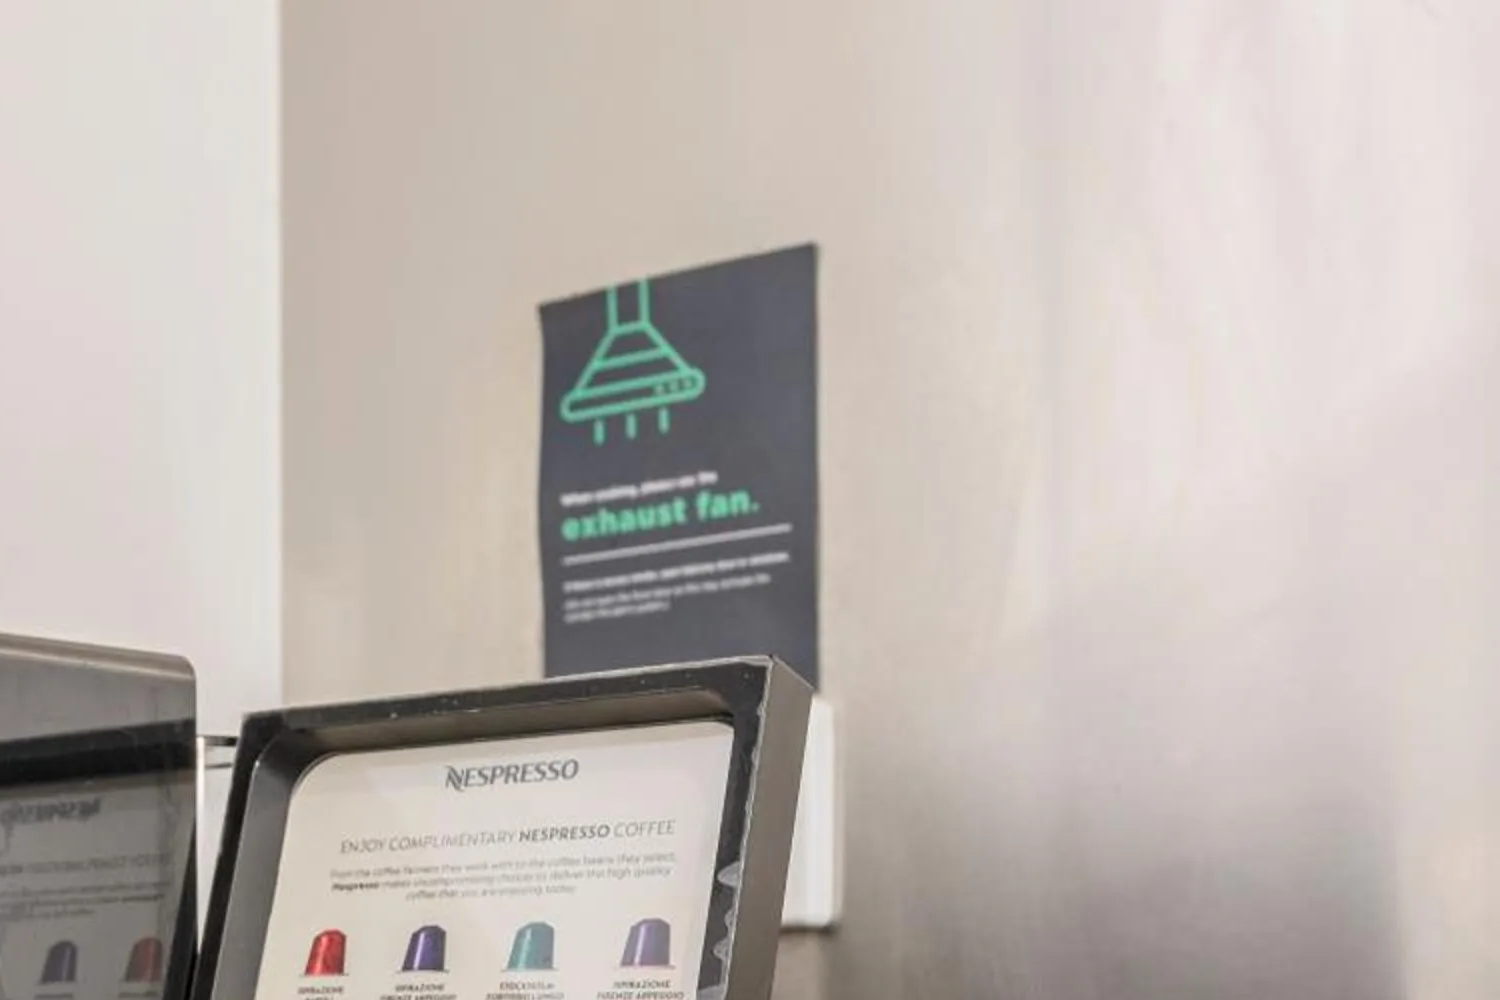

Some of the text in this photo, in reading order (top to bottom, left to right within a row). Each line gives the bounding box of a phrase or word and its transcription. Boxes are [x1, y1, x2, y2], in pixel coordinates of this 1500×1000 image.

[561, 489, 761, 541] exhaust fan.
[444, 758, 579, 792] NESPRESSO
[340, 819, 676, 854] ENJOY COMPLIMENTARY NESPRESSO COFFEE
